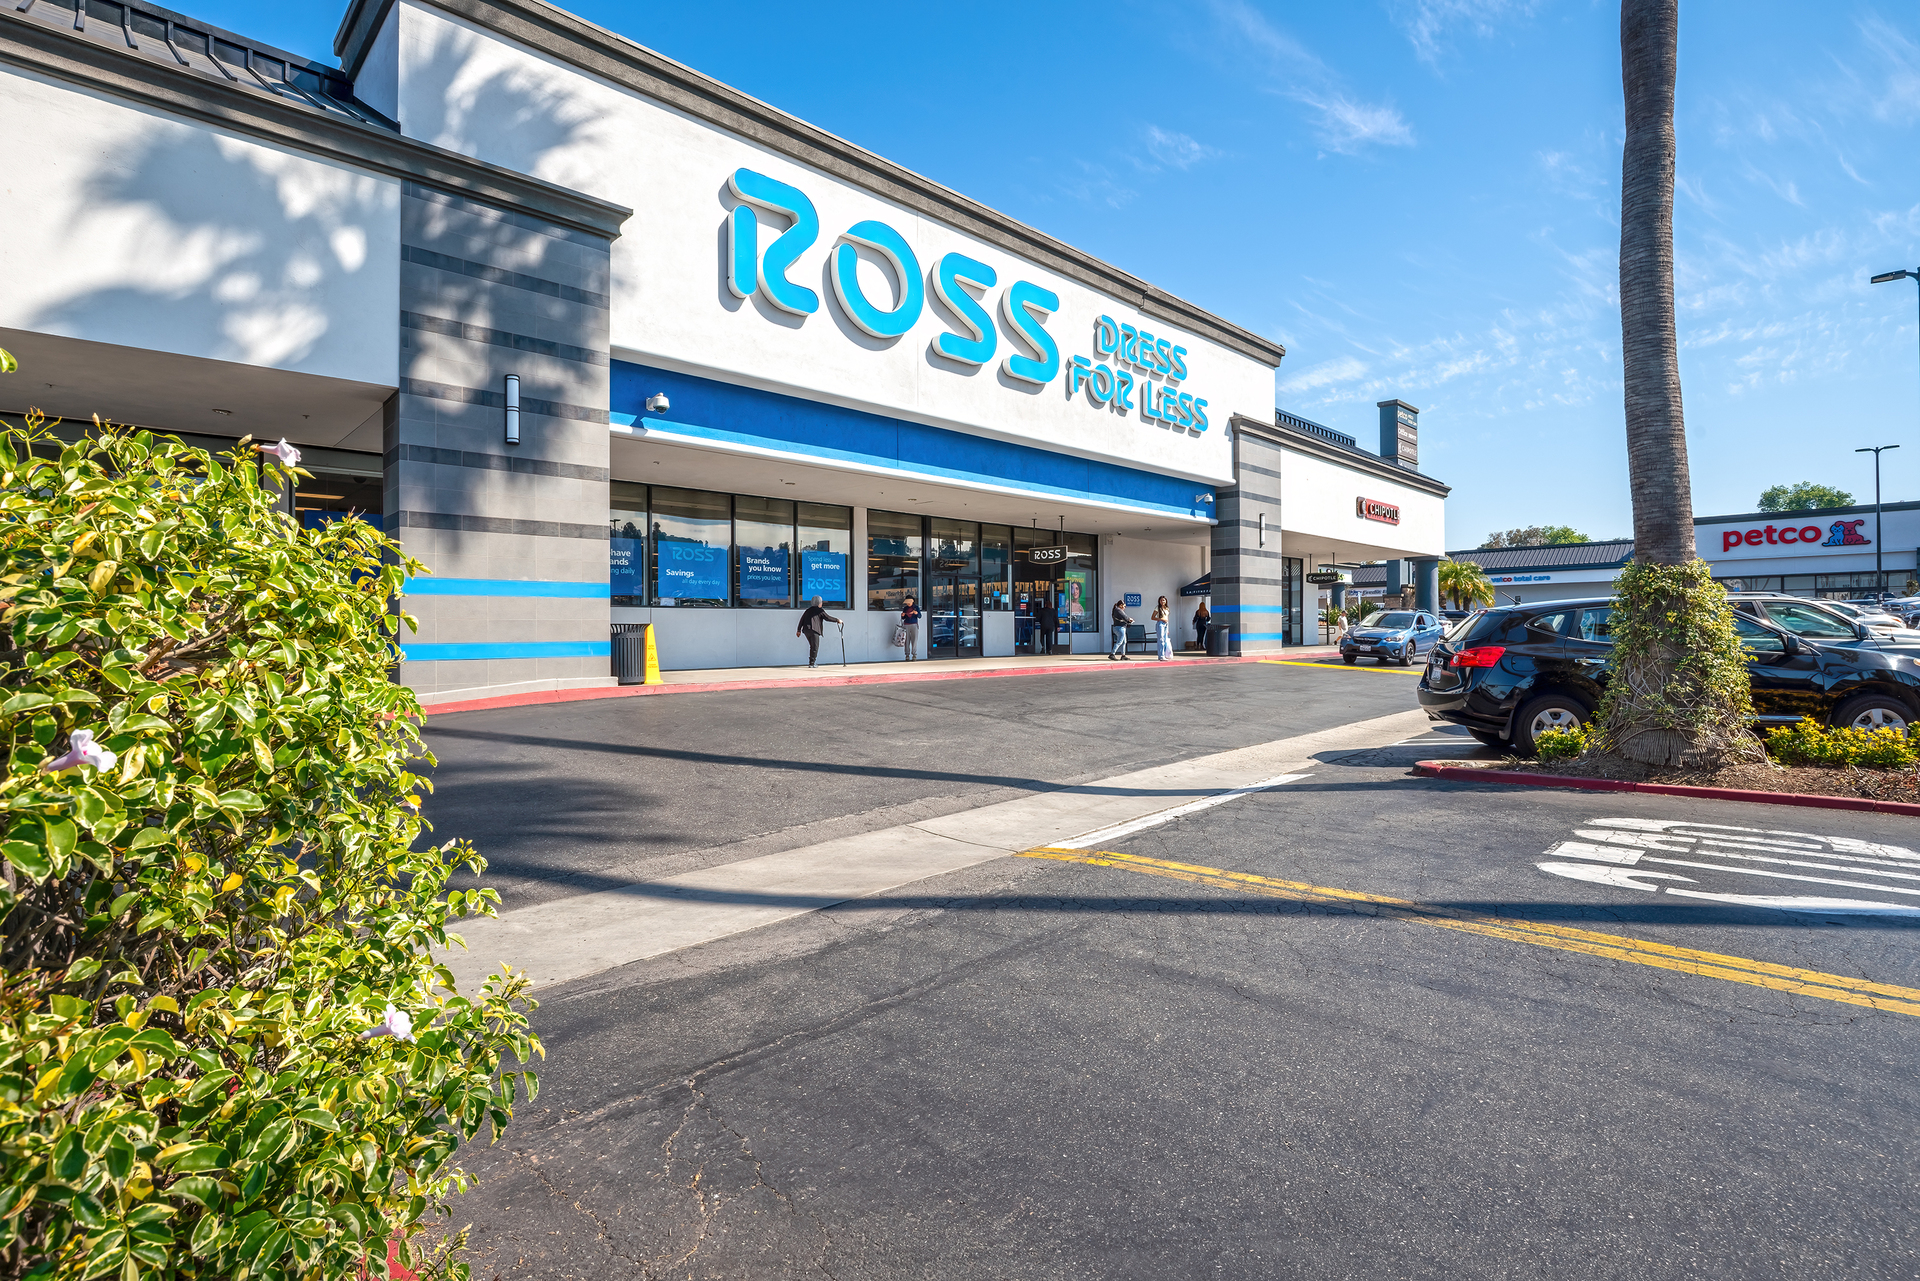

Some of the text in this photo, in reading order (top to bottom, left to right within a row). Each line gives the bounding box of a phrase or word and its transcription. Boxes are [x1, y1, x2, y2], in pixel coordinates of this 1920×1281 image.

[727, 167, 1060, 384] ROSS
[1096, 314, 1188, 381] DRESS
[1068, 355, 1208, 432] FOR LESS
[1370, 502, 1400, 520] CHIPOTLE
[1723, 525, 1822, 552] petco
[672, 547, 715, 562] ROSS
[1034, 549, 1061, 560] ROSS
[620, 567, 635, 575] daily
[666, 569, 695, 578] Savings
[763, 565, 782, 573] know
[808, 578, 841, 590] ROSS
